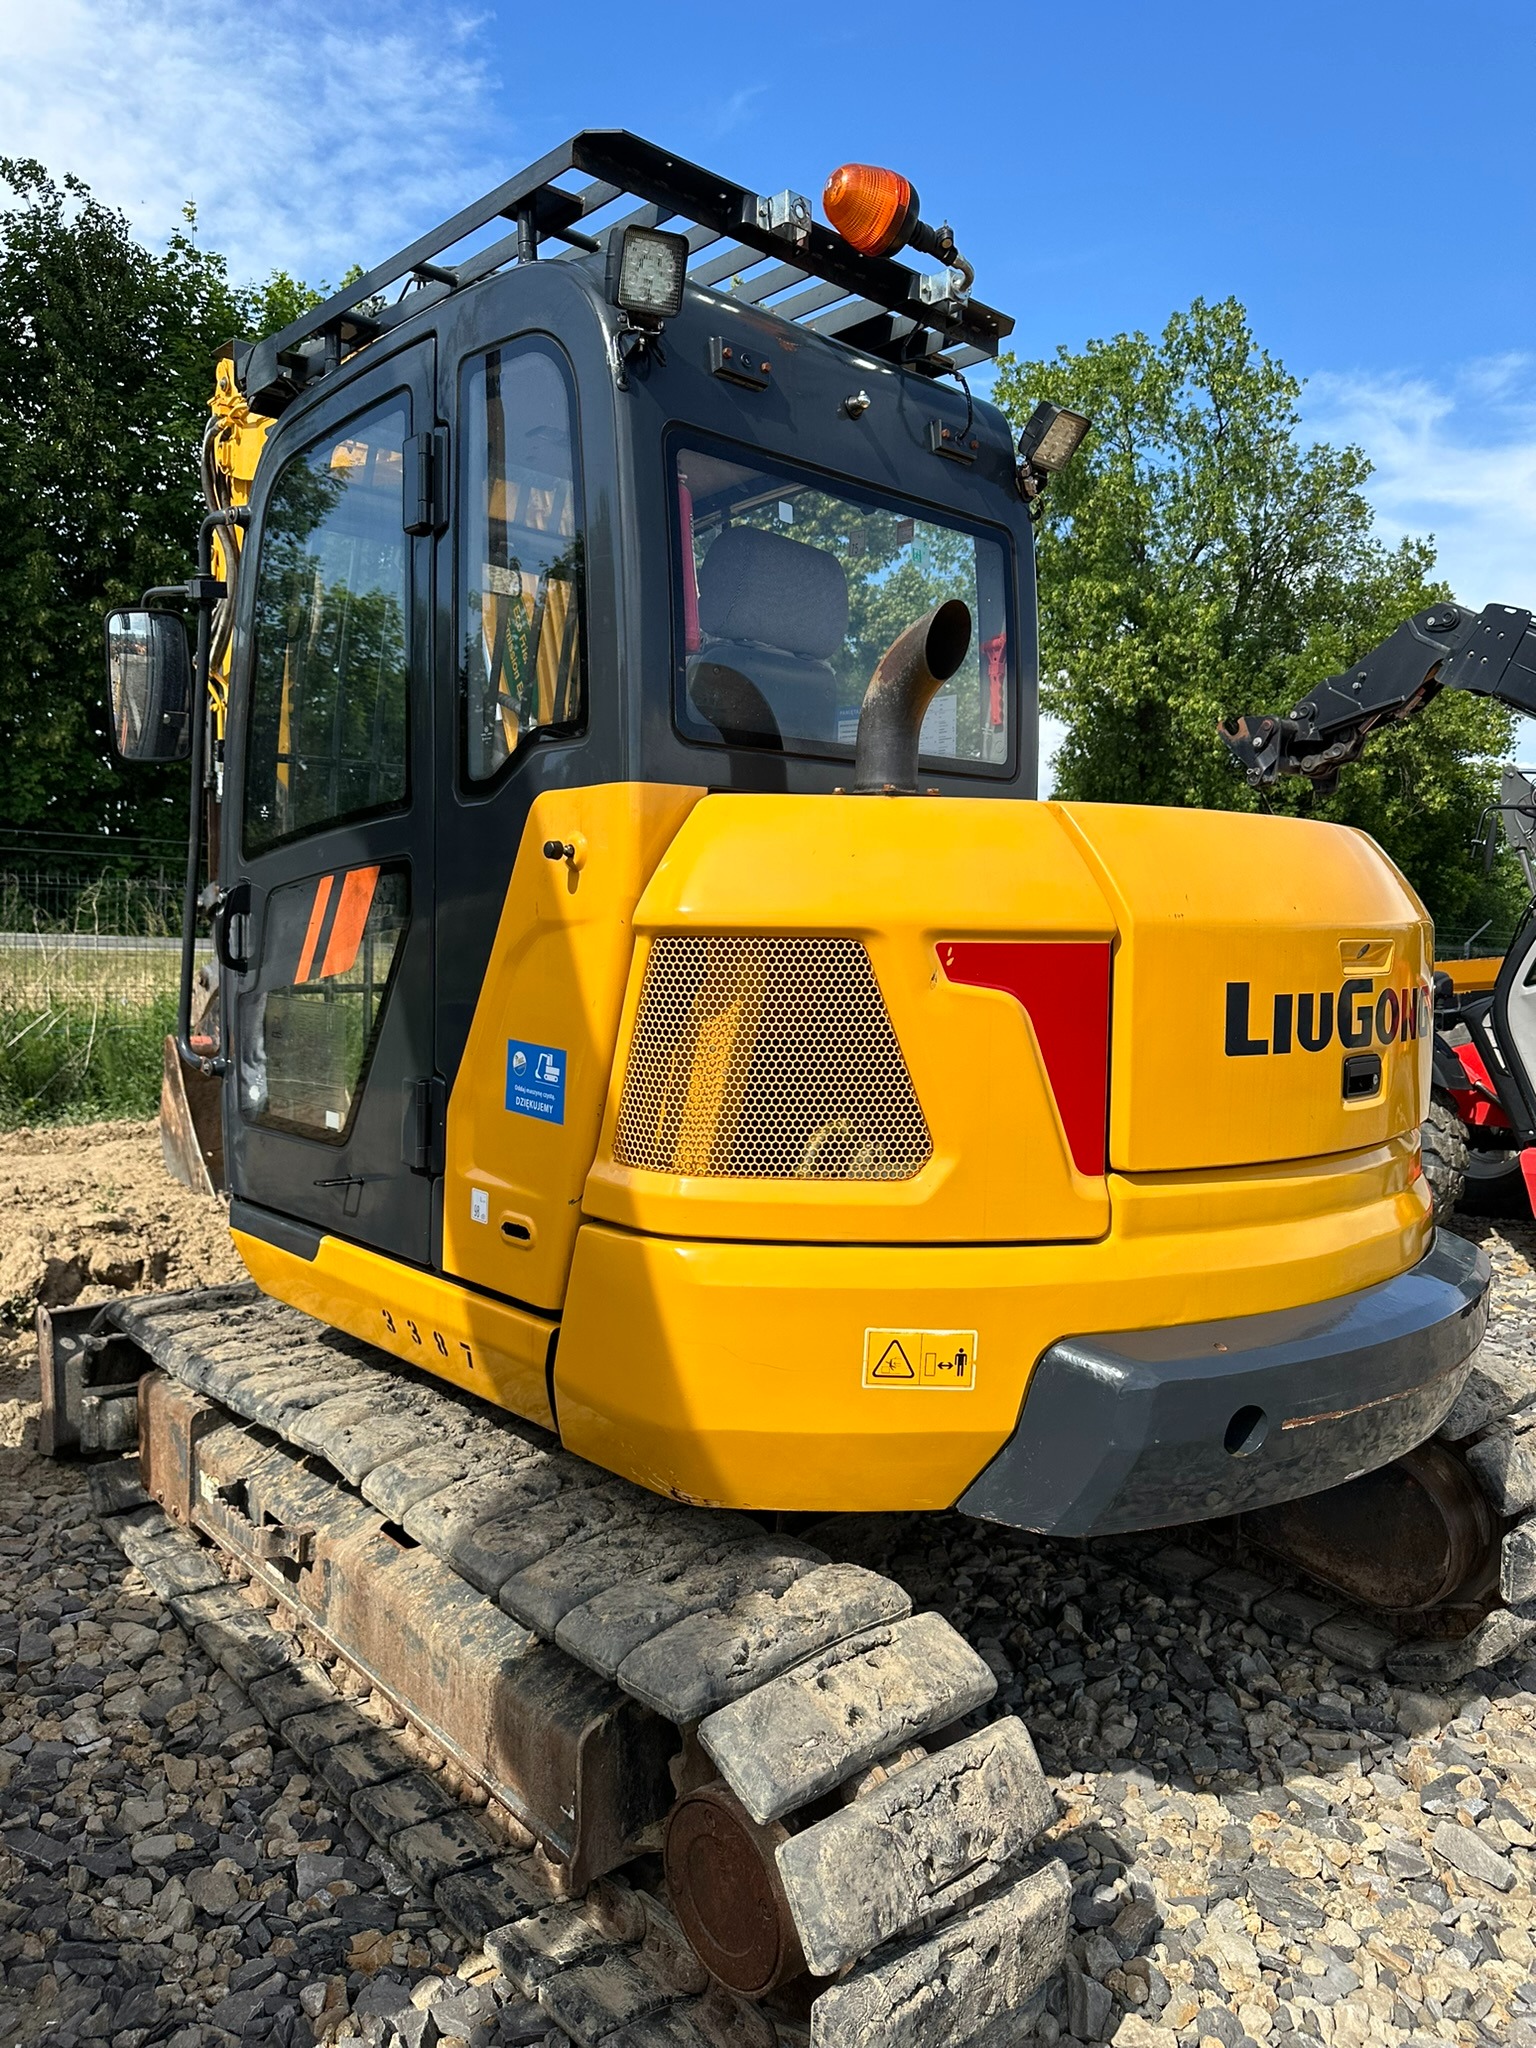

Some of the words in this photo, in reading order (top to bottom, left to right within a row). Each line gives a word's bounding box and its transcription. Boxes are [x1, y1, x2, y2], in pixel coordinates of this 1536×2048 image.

[512, 605, 522, 632] Eco
[519, 633, 529, 664] Frie
[515, 1096, 554, 1114] DZIĘKUJEMY
[382, 1309, 474, 1369] 3387
